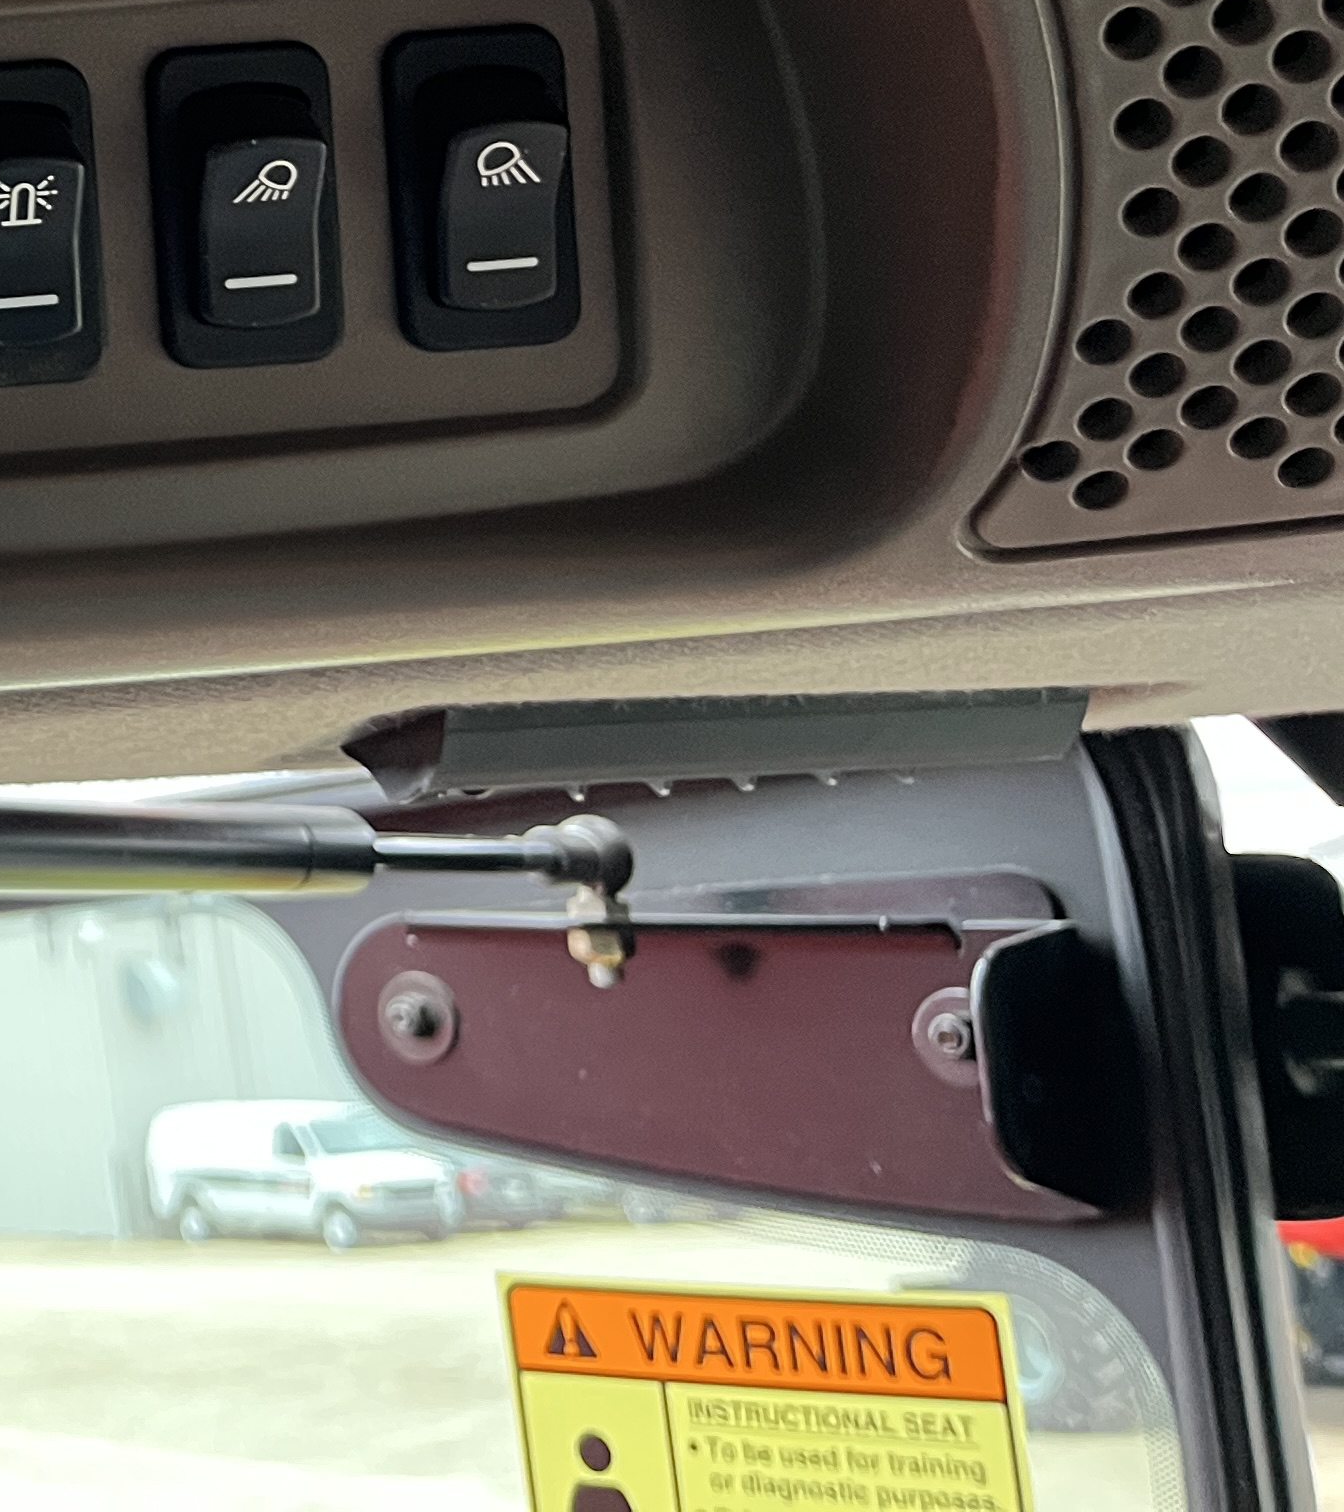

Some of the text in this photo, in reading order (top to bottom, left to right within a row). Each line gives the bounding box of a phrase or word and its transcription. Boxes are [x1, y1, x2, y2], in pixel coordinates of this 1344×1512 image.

[628, 1308, 953, 1382] WARNING
[688, 1395, 975, 1439] INSTRUCTIONAL SEAT
[705, 1435, 987, 1486] To be used for training
[709, 1472, 734, 1493] or
[741, 1470, 871, 1506] diagnostic
